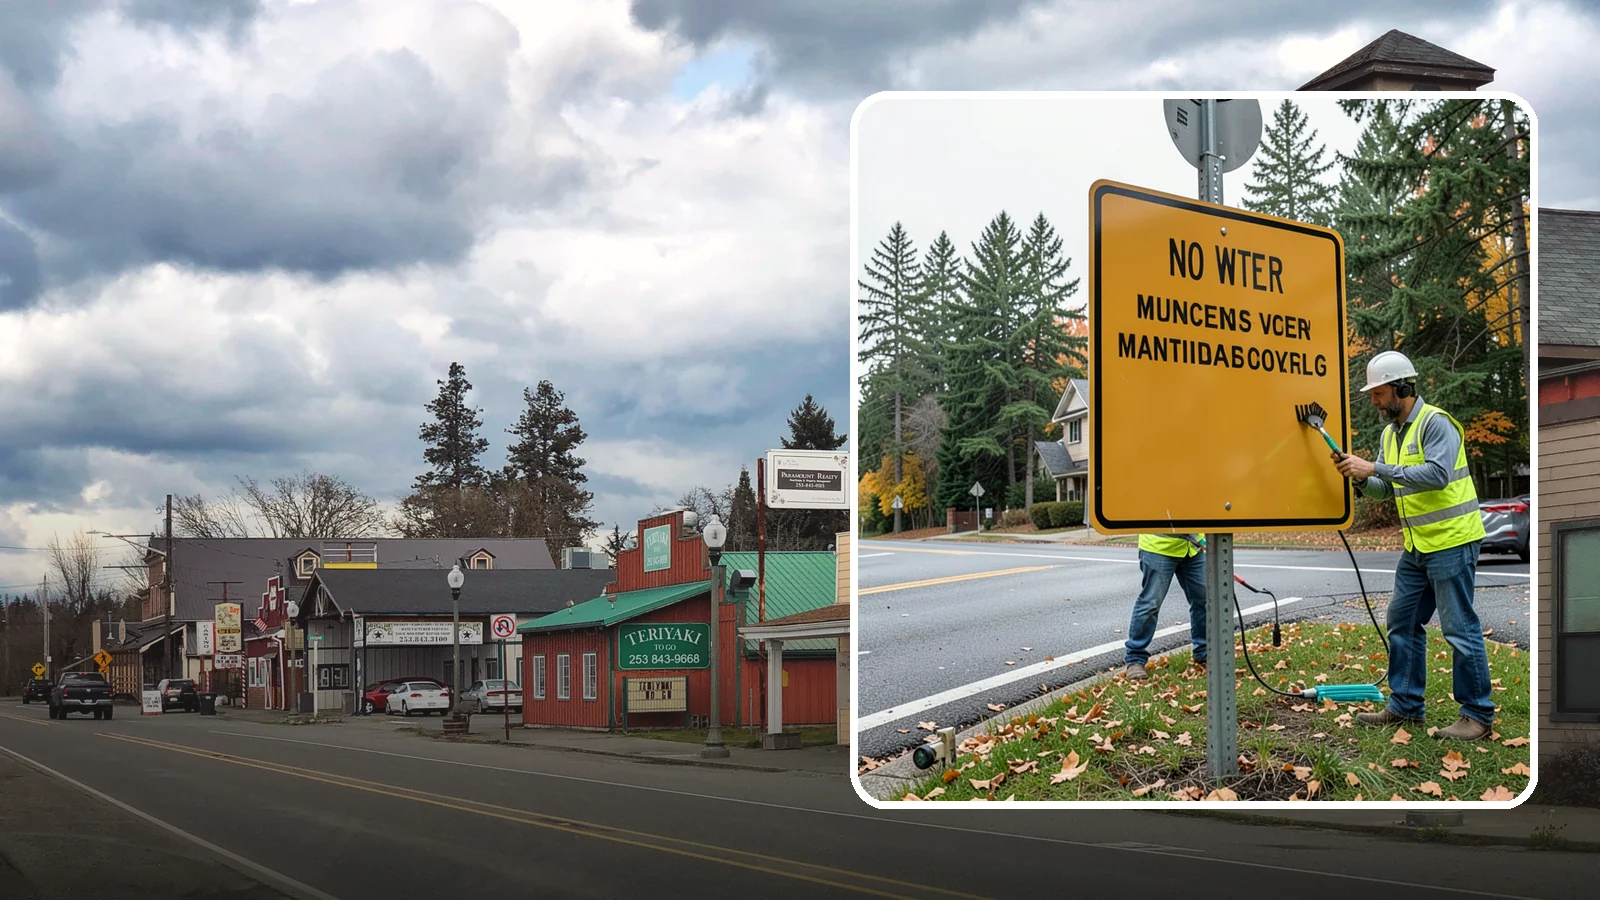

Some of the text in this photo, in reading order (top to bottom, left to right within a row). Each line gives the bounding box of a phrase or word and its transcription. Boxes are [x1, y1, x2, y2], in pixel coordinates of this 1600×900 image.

[1169, 238, 1284, 294] NO WTER
[781, 471, 839, 480] PARAMOUNT REALTY
[625, 627, 702, 646] TERIYAKI
[654, 643, 676, 651] TO GO
[628, 654, 700, 664] 253 843-9668
